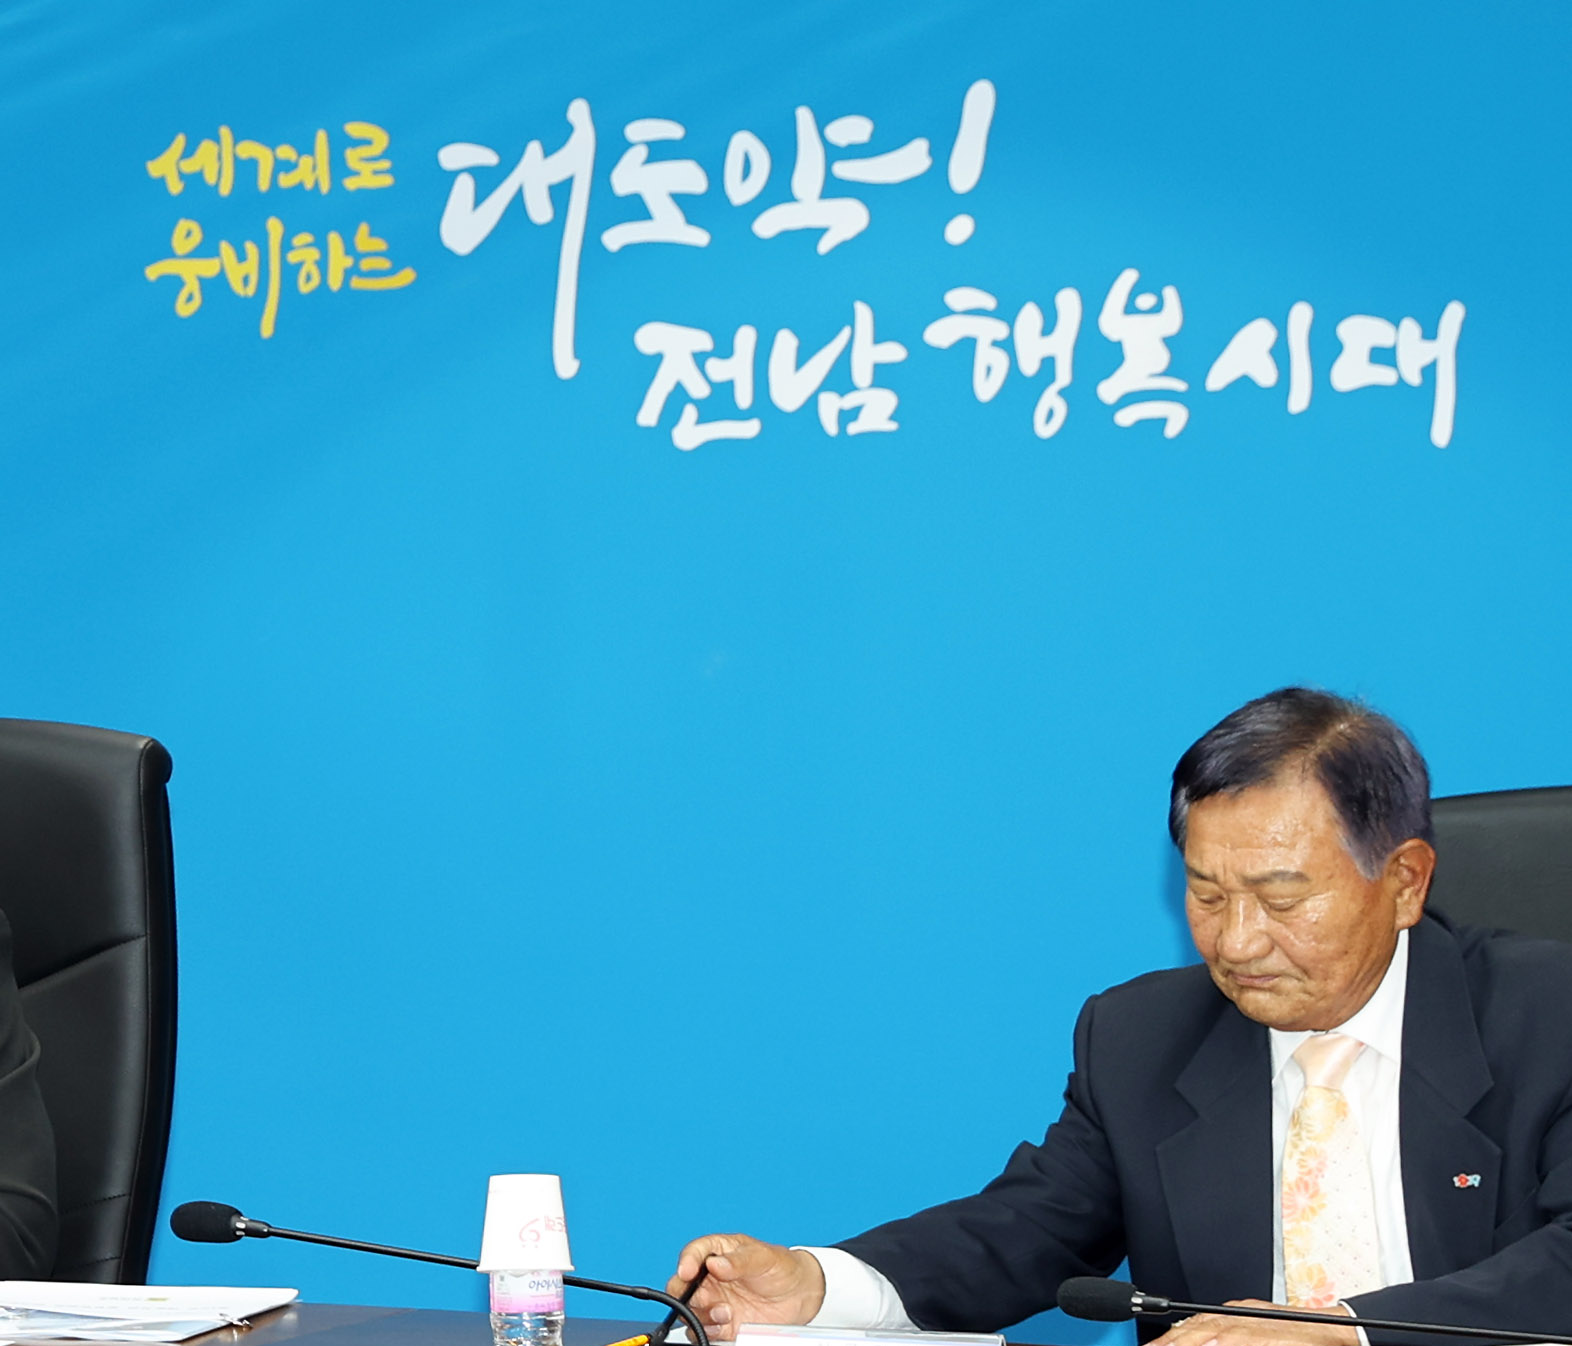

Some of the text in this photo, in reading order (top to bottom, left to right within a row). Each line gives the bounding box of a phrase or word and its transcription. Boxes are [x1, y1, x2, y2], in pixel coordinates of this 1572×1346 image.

[146, 121, 395, 197] 세계로
[144, 216, 417, 339] 웅비하는
[437, 79, 996, 379] 대도약!
[633, 300, 909, 452] 전남
